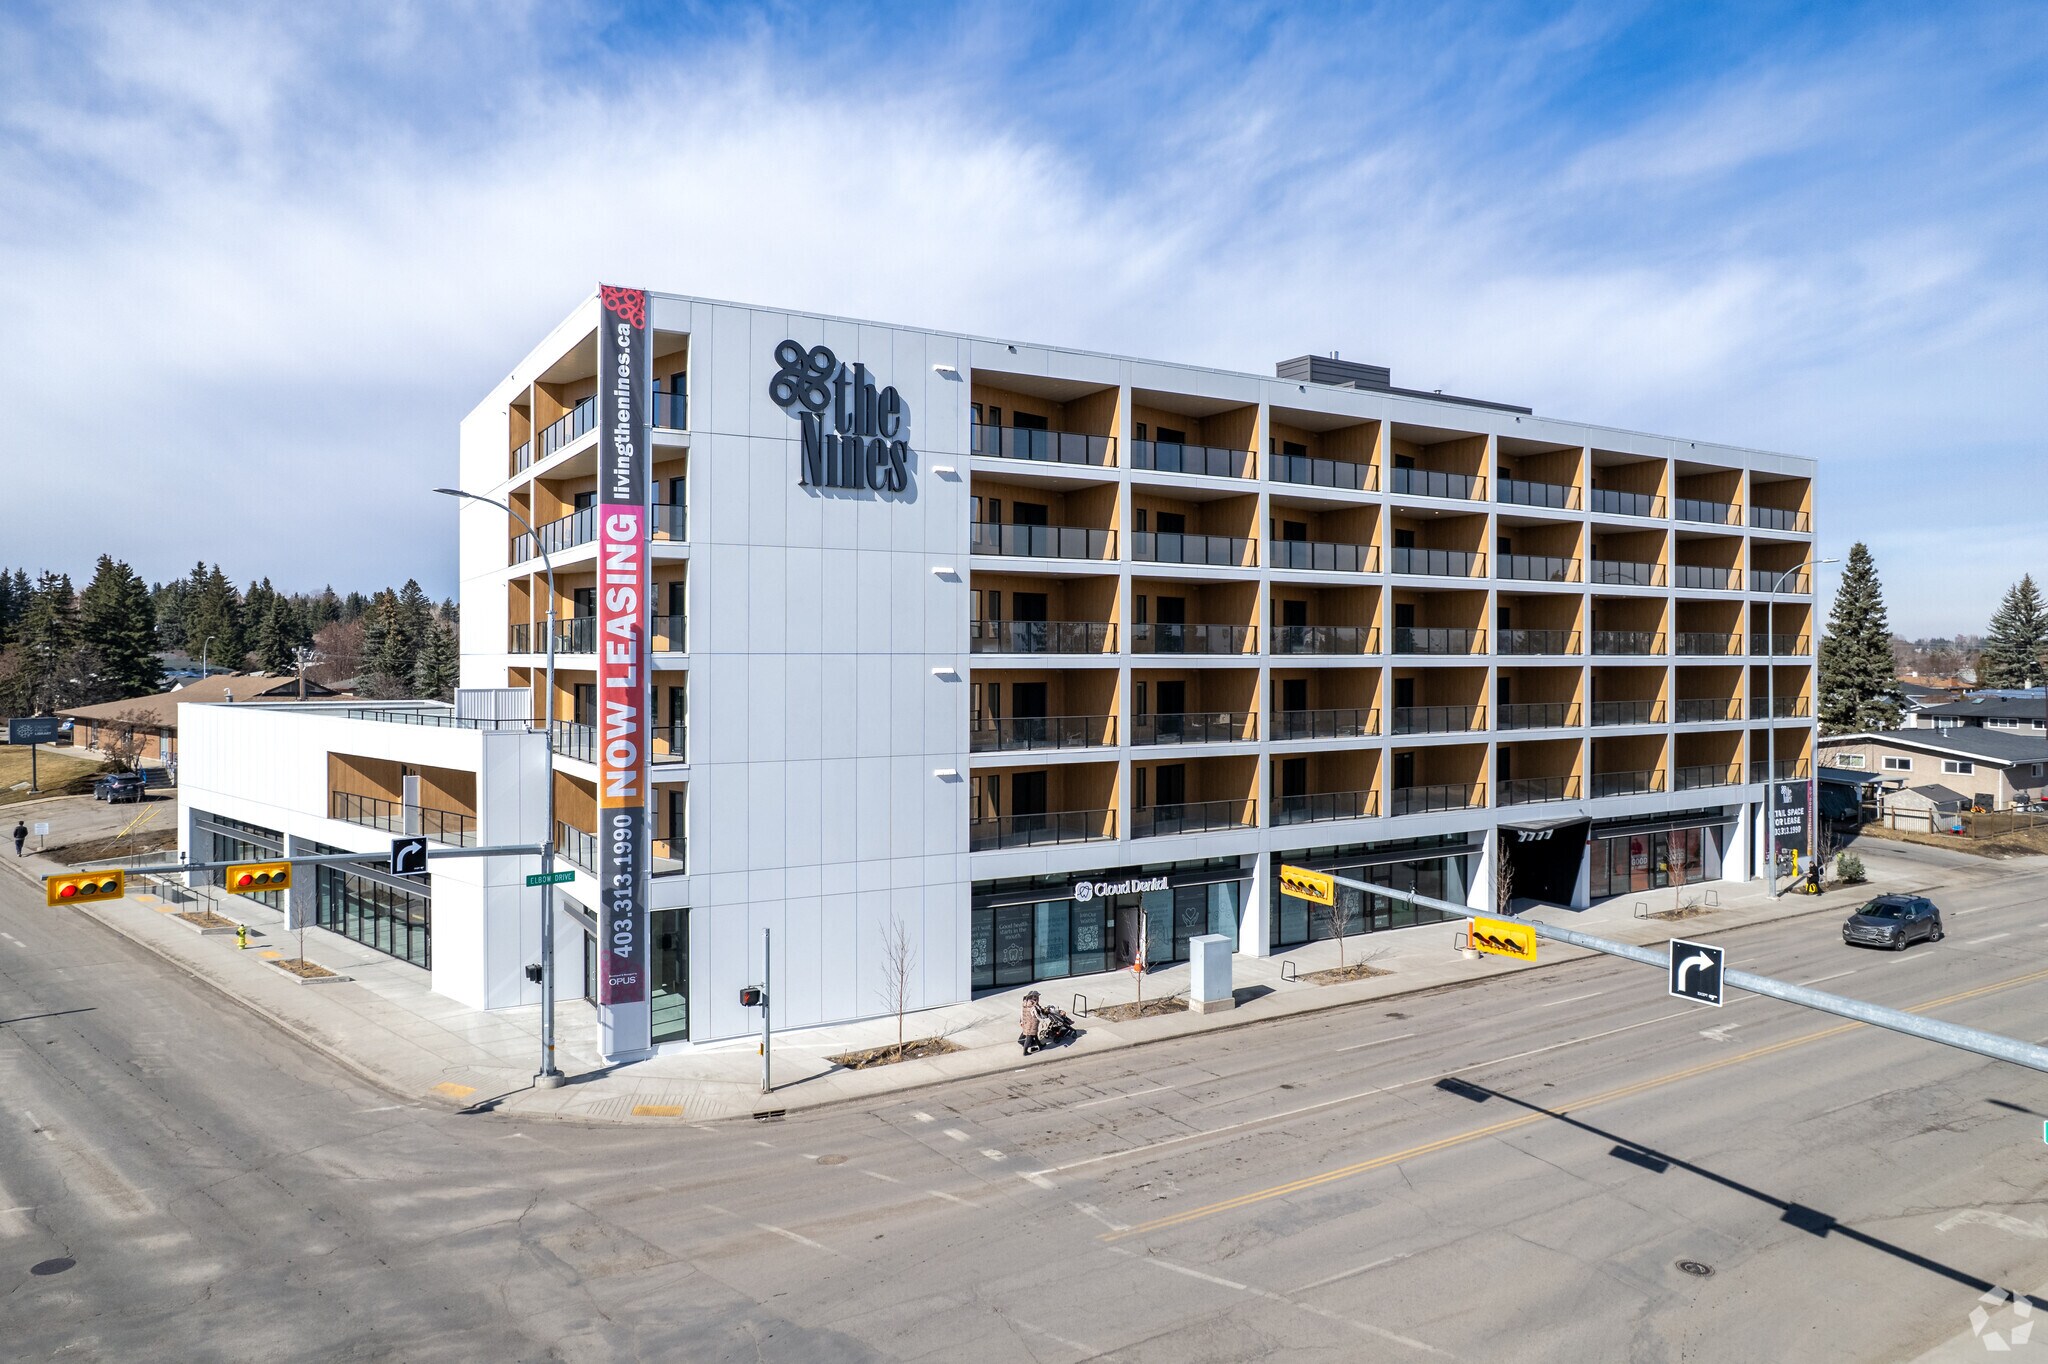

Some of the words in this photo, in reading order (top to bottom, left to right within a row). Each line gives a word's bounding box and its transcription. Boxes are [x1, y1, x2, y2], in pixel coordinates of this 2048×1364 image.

[614, 323, 634, 499] livingthenines.ca
[833, 361, 900, 438] the
[798, 410, 908, 492] Nines
[606, 514, 637, 688] LEASING
[606, 701, 637, 798] NOW
[1774, 818, 1784, 826] OR
[1784, 816, 1801, 825] LEASE
[1787, 808, 1804, 816] SPACE
[530, 876, 552, 885] ELBOW
[554, 873, 572, 881] DRIVE
[1631, 857, 1648, 866] GOOD
[613, 814, 633, 958] 403.313.1990
[1094, 880, 1131, 897] Cloud
[609, 977, 636, 985] OPUS
